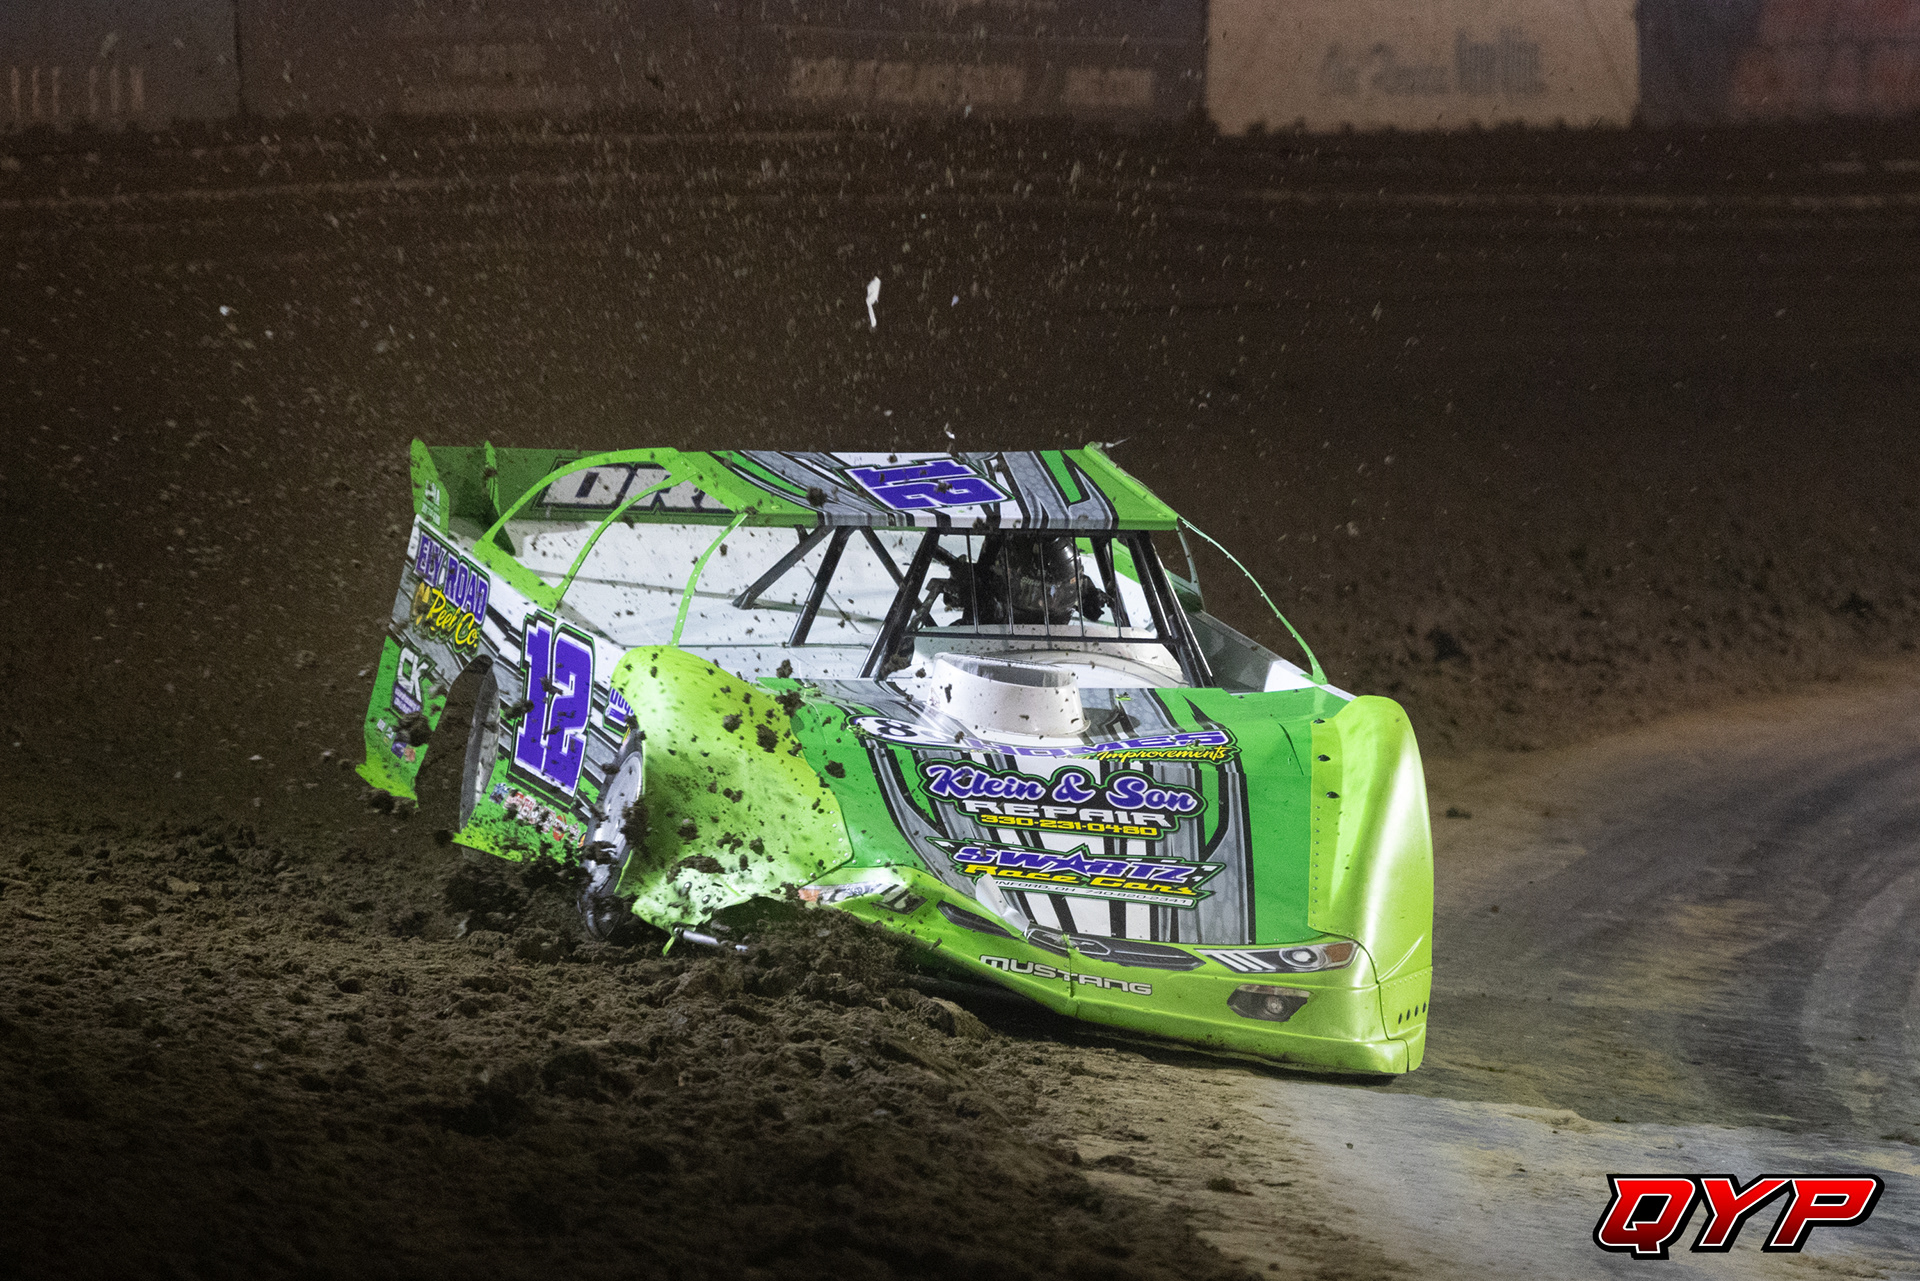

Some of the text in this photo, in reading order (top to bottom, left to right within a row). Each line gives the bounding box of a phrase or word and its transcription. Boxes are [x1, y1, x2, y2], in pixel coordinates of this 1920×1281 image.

[843, 458, 1010, 510] 12
[443, 552, 489, 625] ROAD
[513, 624, 596, 797] 12
[1096, 745, 1230, 763] Improvements
[928, 764, 1198, 811] Klein & Son
[961, 800, 1172, 828] REPAIR
[979, 814, 1158, 836] 330-231-0480
[953, 846, 1198, 884] SWARTZ
[964, 864, 1197, 896] Race Cars
[995, 879, 1052, 891] INFORD,
[980, 955, 1152, 996] MUSTANG
